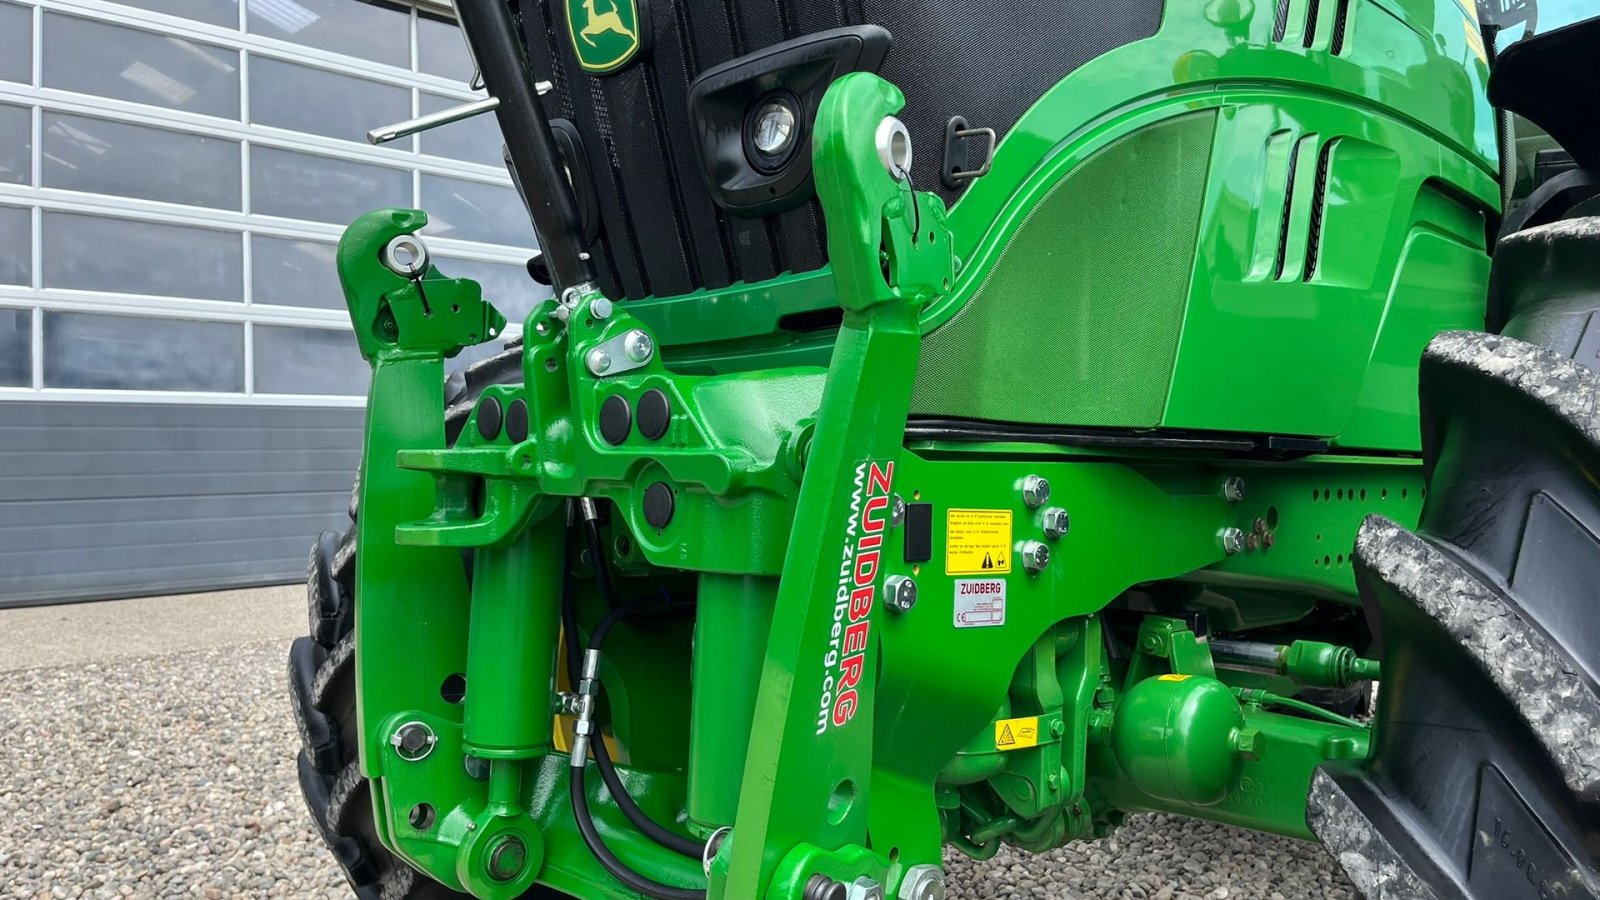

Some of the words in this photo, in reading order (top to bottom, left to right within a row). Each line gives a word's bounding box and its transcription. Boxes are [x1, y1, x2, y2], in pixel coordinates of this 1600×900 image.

[816, 462, 867, 735] www.zuidberg.com
[833, 461, 894, 727] ZUIDBERG
[960, 582, 1002, 595] ZUIDBERG
